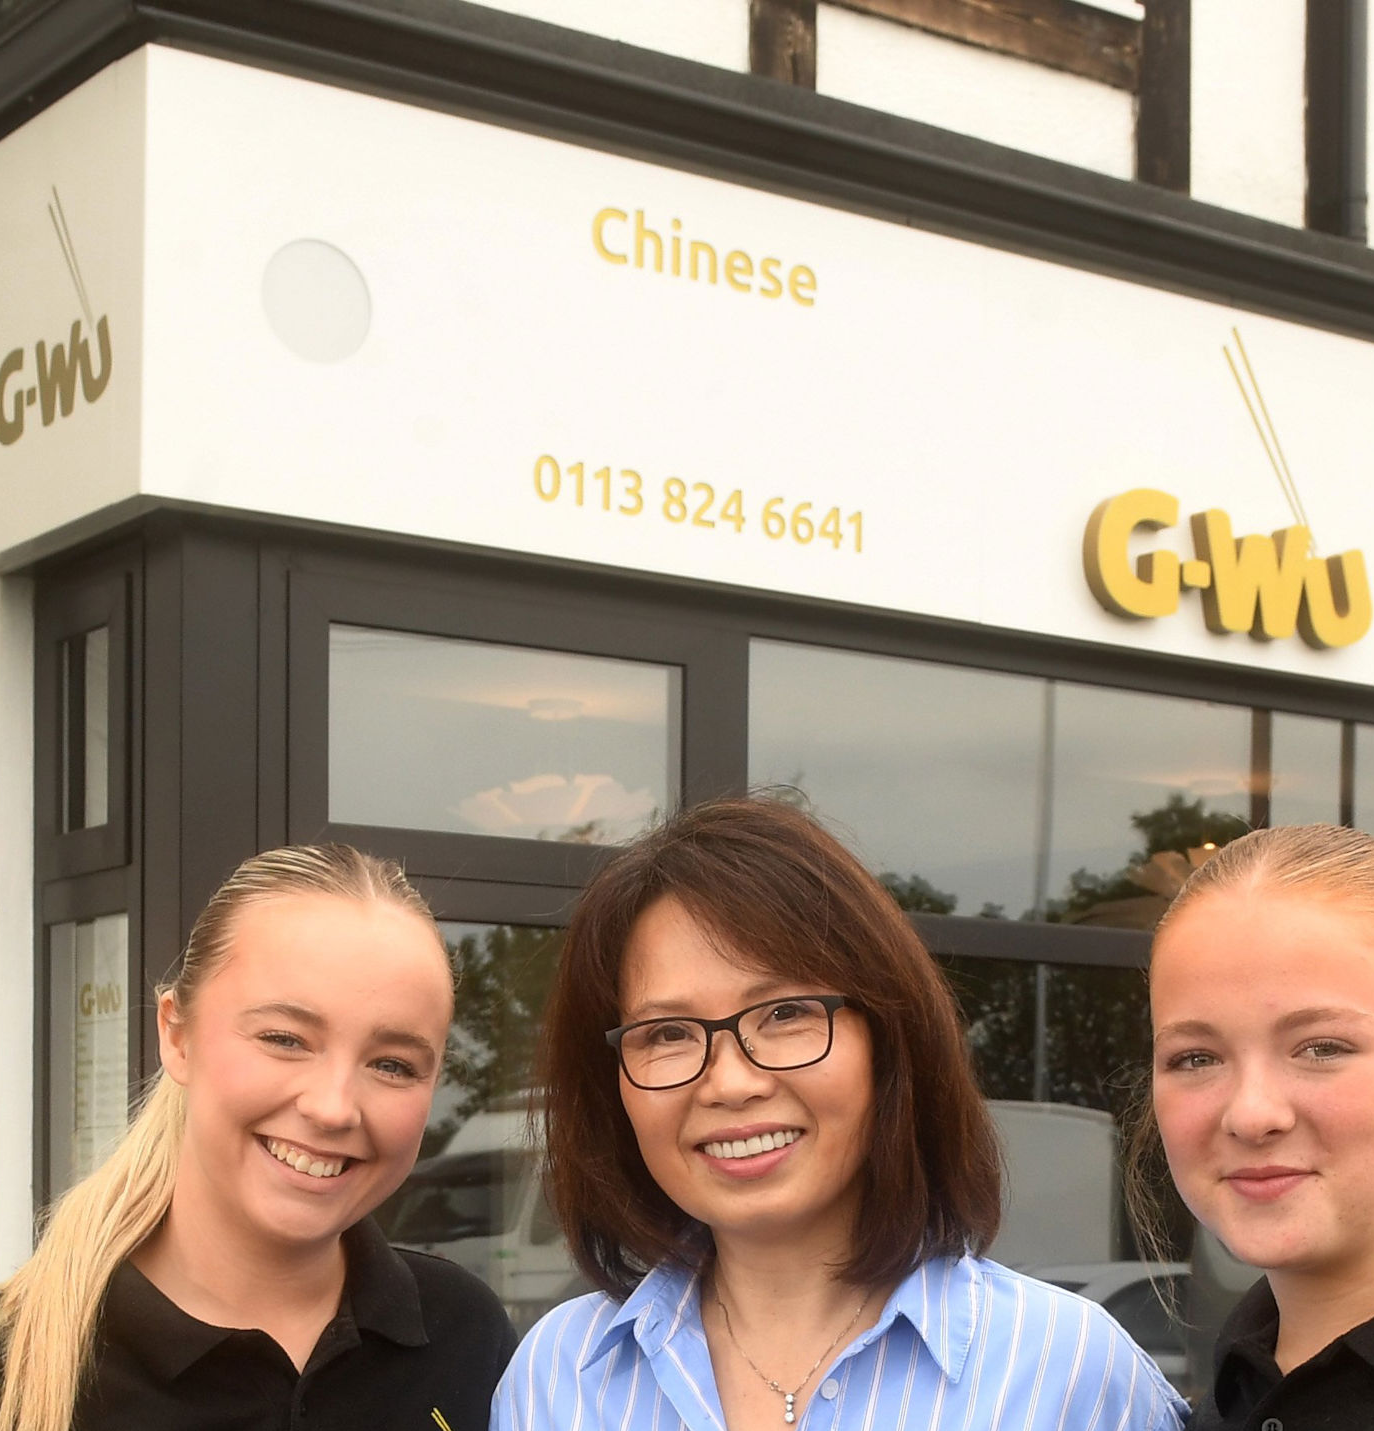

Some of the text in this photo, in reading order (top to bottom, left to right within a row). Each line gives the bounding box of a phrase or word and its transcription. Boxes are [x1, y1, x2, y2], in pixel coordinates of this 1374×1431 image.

[591, 207, 818, 307] Chinese
[533, 454, 863, 553] 0113 824 6641
[1082, 487, 1374, 650] G-WU
